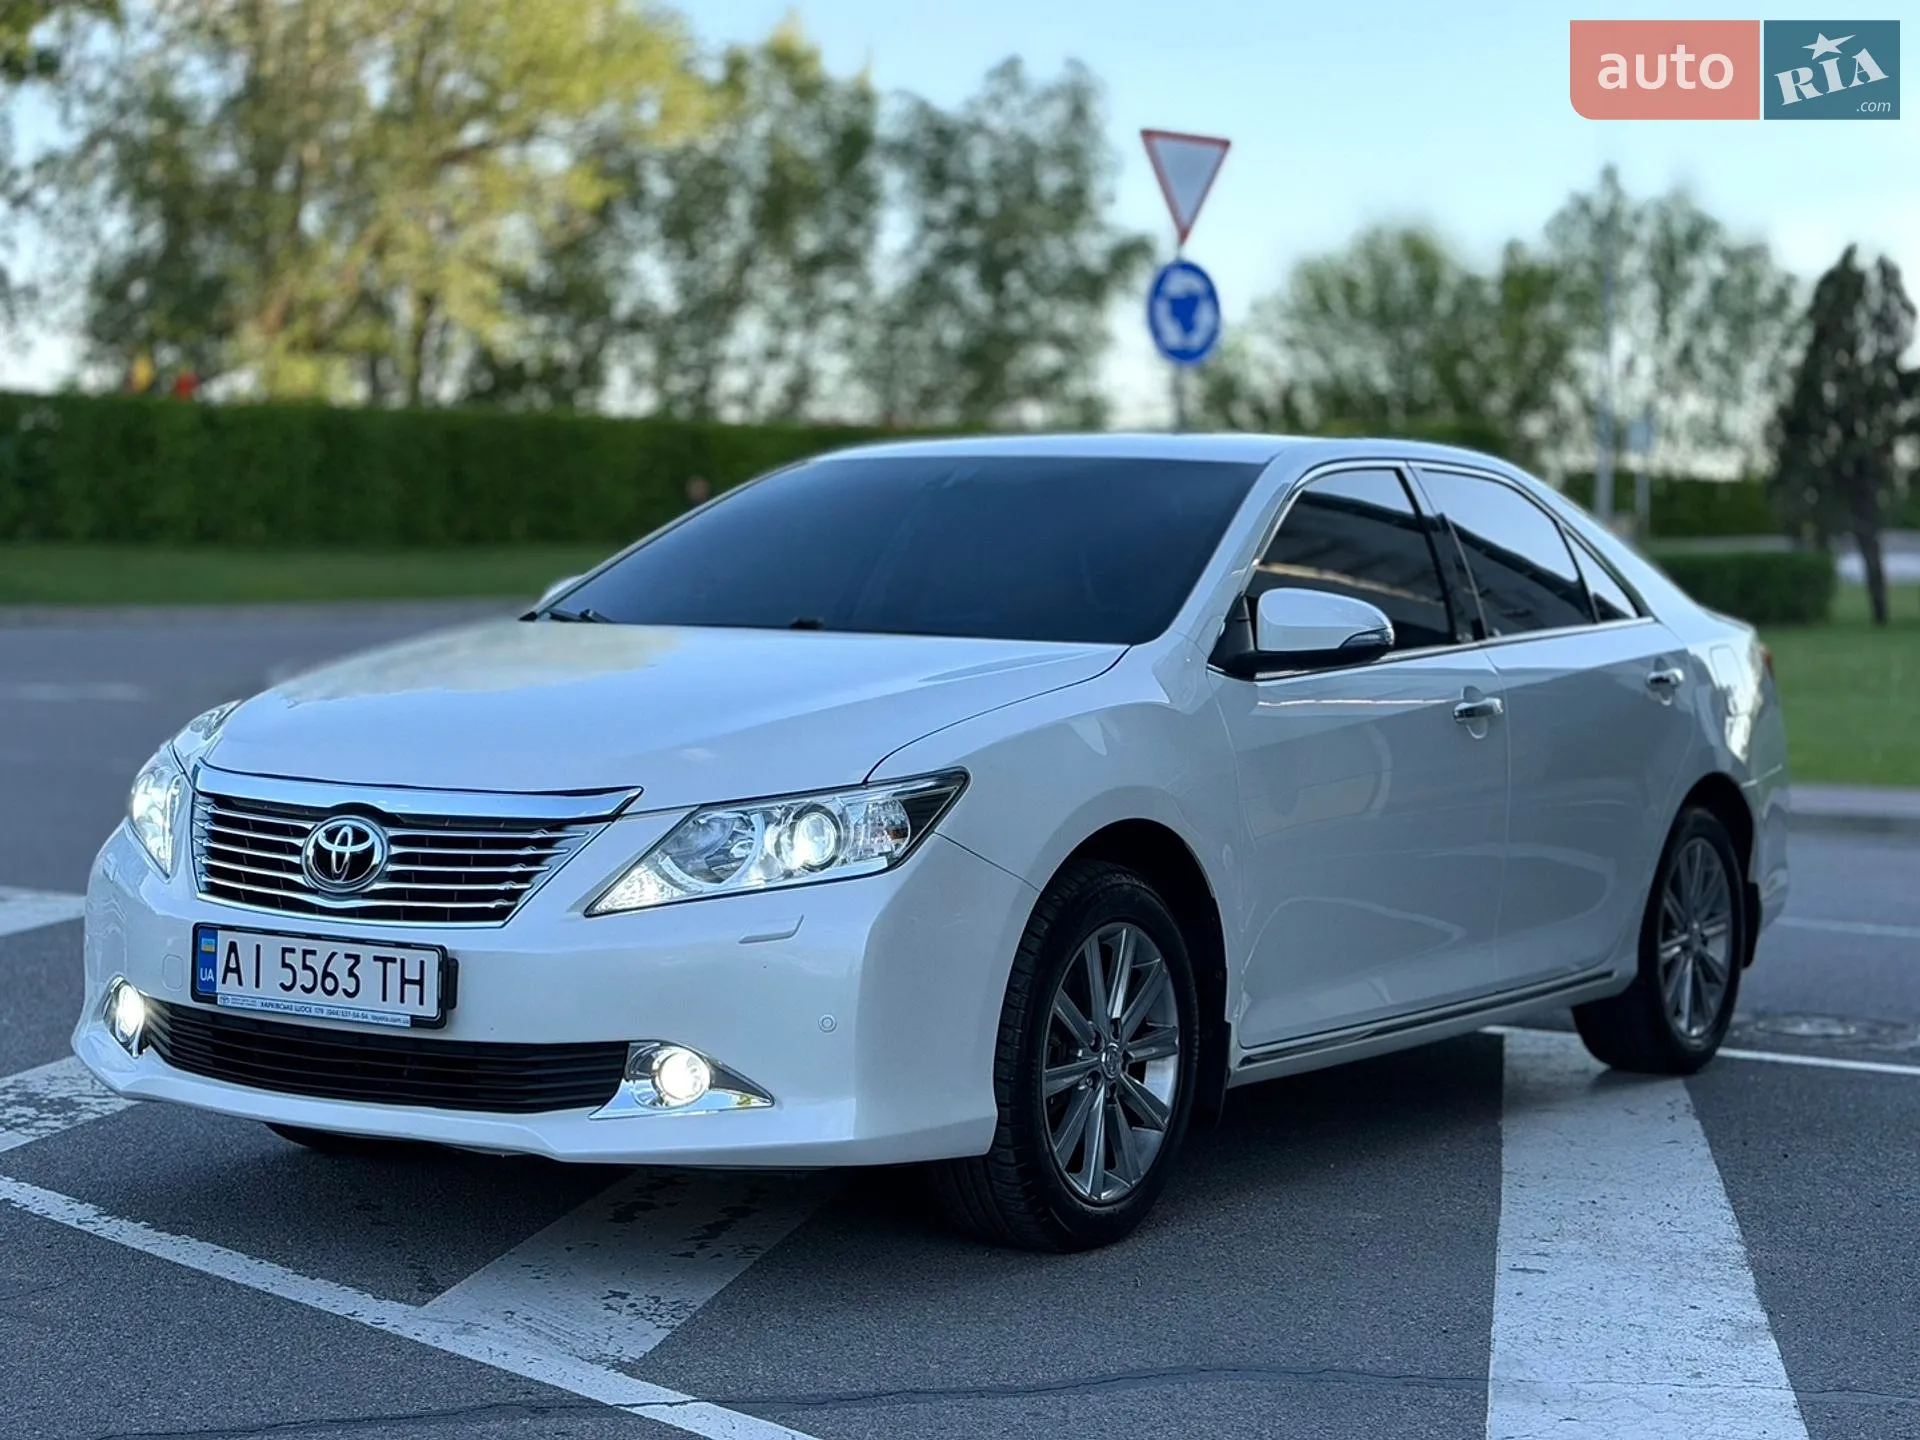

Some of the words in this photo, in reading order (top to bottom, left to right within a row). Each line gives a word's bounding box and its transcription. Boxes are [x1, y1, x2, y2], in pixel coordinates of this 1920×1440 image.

[200, 967, 215, 982] UA
[221, 941, 261, 989] AI
[279, 946, 361, 999] 5563
[373, 955, 425, 1007] TH
